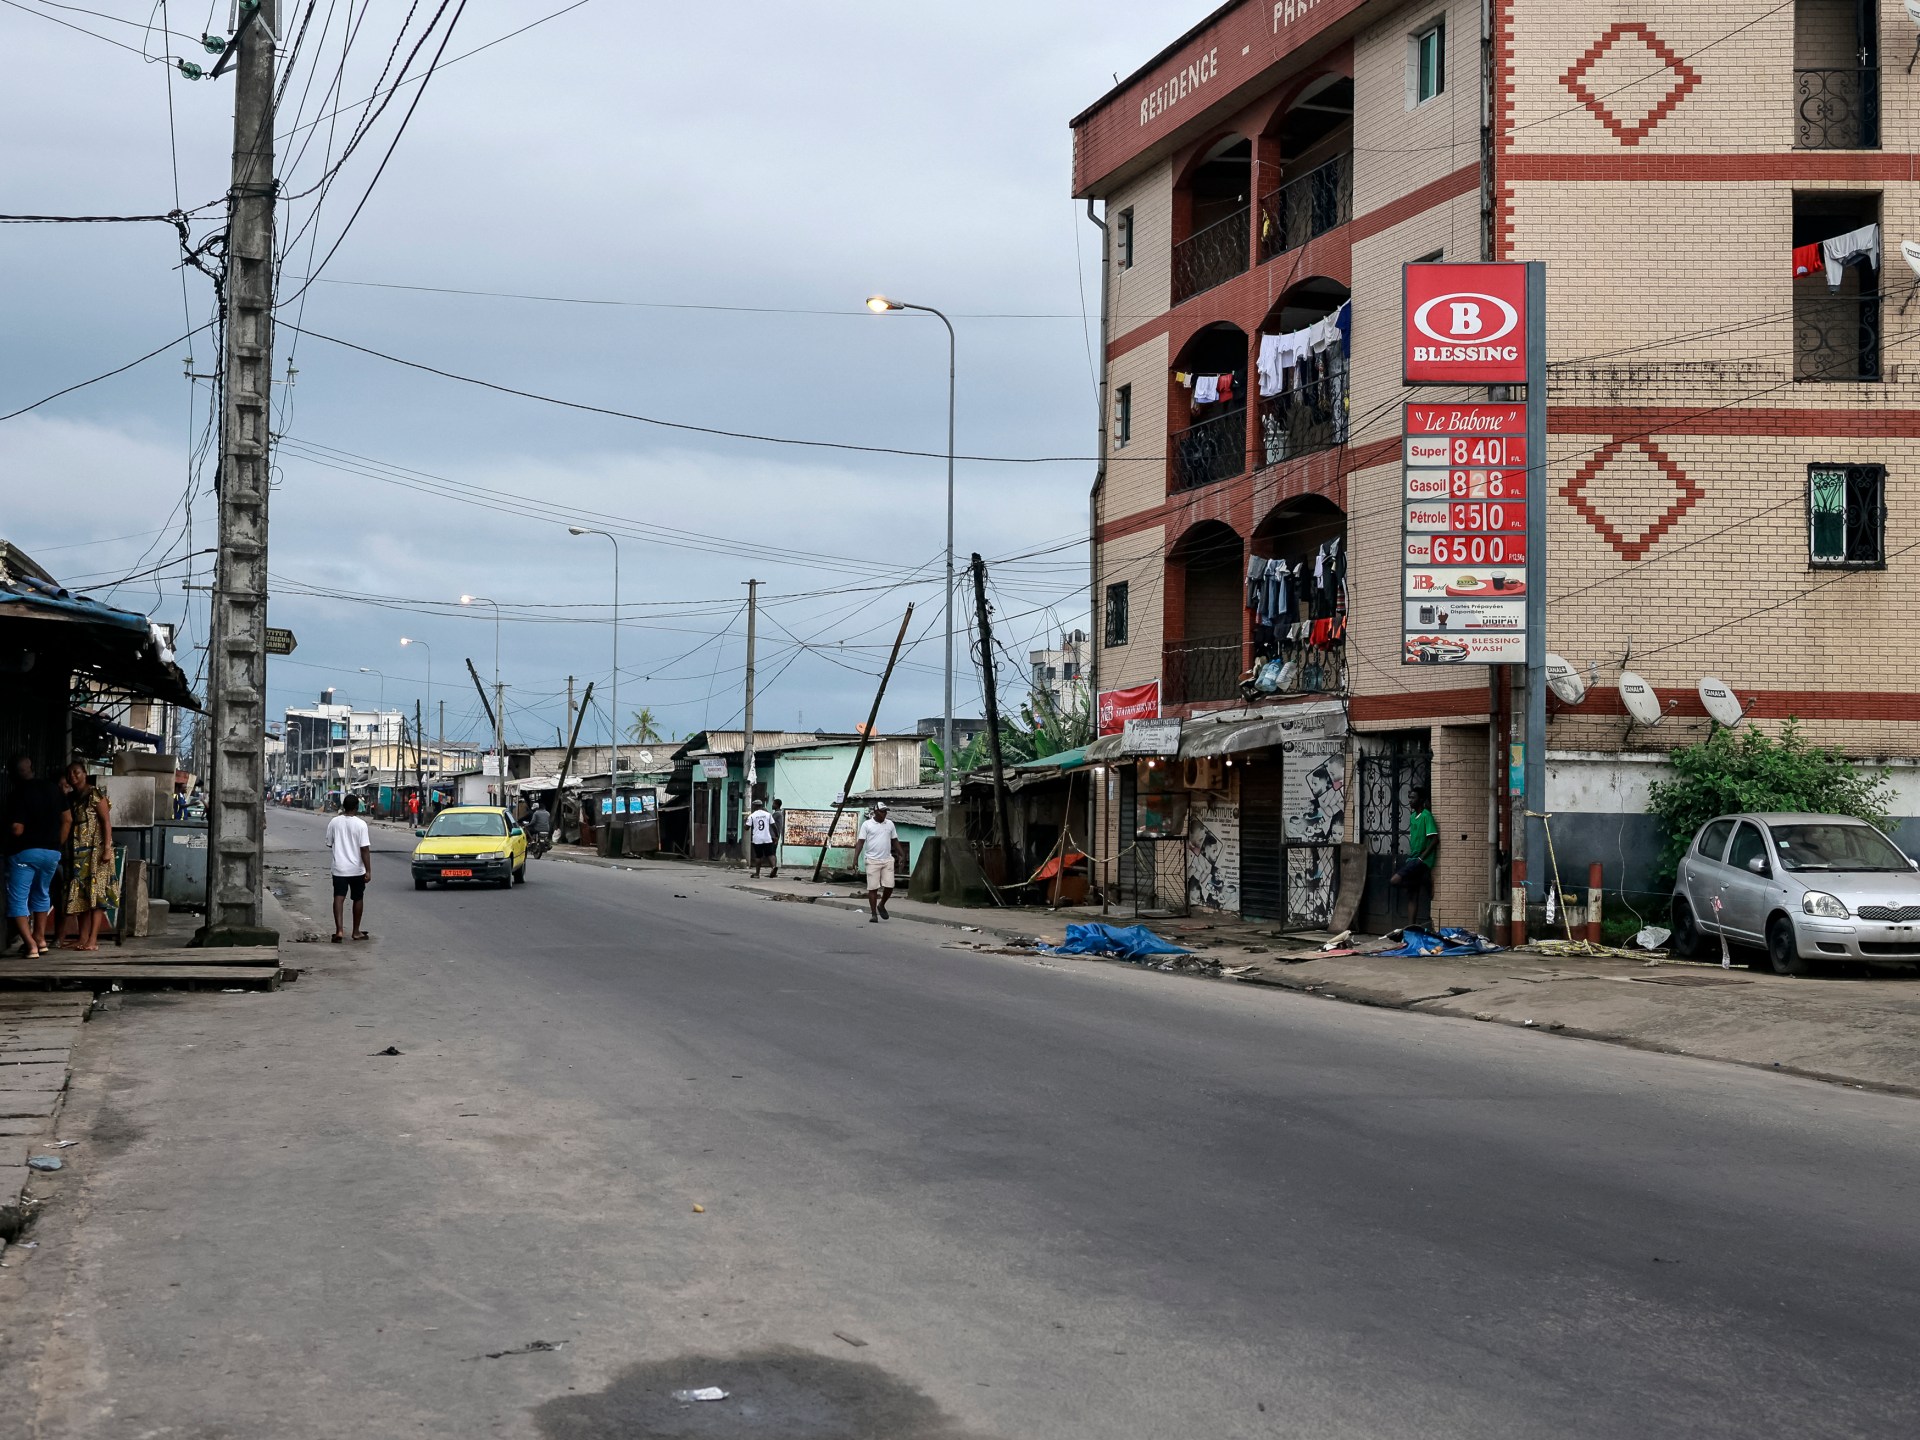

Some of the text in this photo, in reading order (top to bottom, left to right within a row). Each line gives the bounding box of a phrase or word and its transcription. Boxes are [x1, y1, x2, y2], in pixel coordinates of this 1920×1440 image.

[1449, 302, 1483, 335] B
[1413, 346, 1519, 362] BLESSING
[1411, 445, 1447, 458] Super
[1410, 479, 1447, 492] Gasoil
[1410, 511, 1447, 524] Pétrole
[1408, 544, 1429, 555] Gaz
[1434, 537, 1504, 563] 6500
[1624, 685, 1644, 693] CANAL+
[1704, 689, 1727, 698] CANAL+
[1294, 741, 1316, 753] BEAUTY
[758, 819, 765, 831] 9
